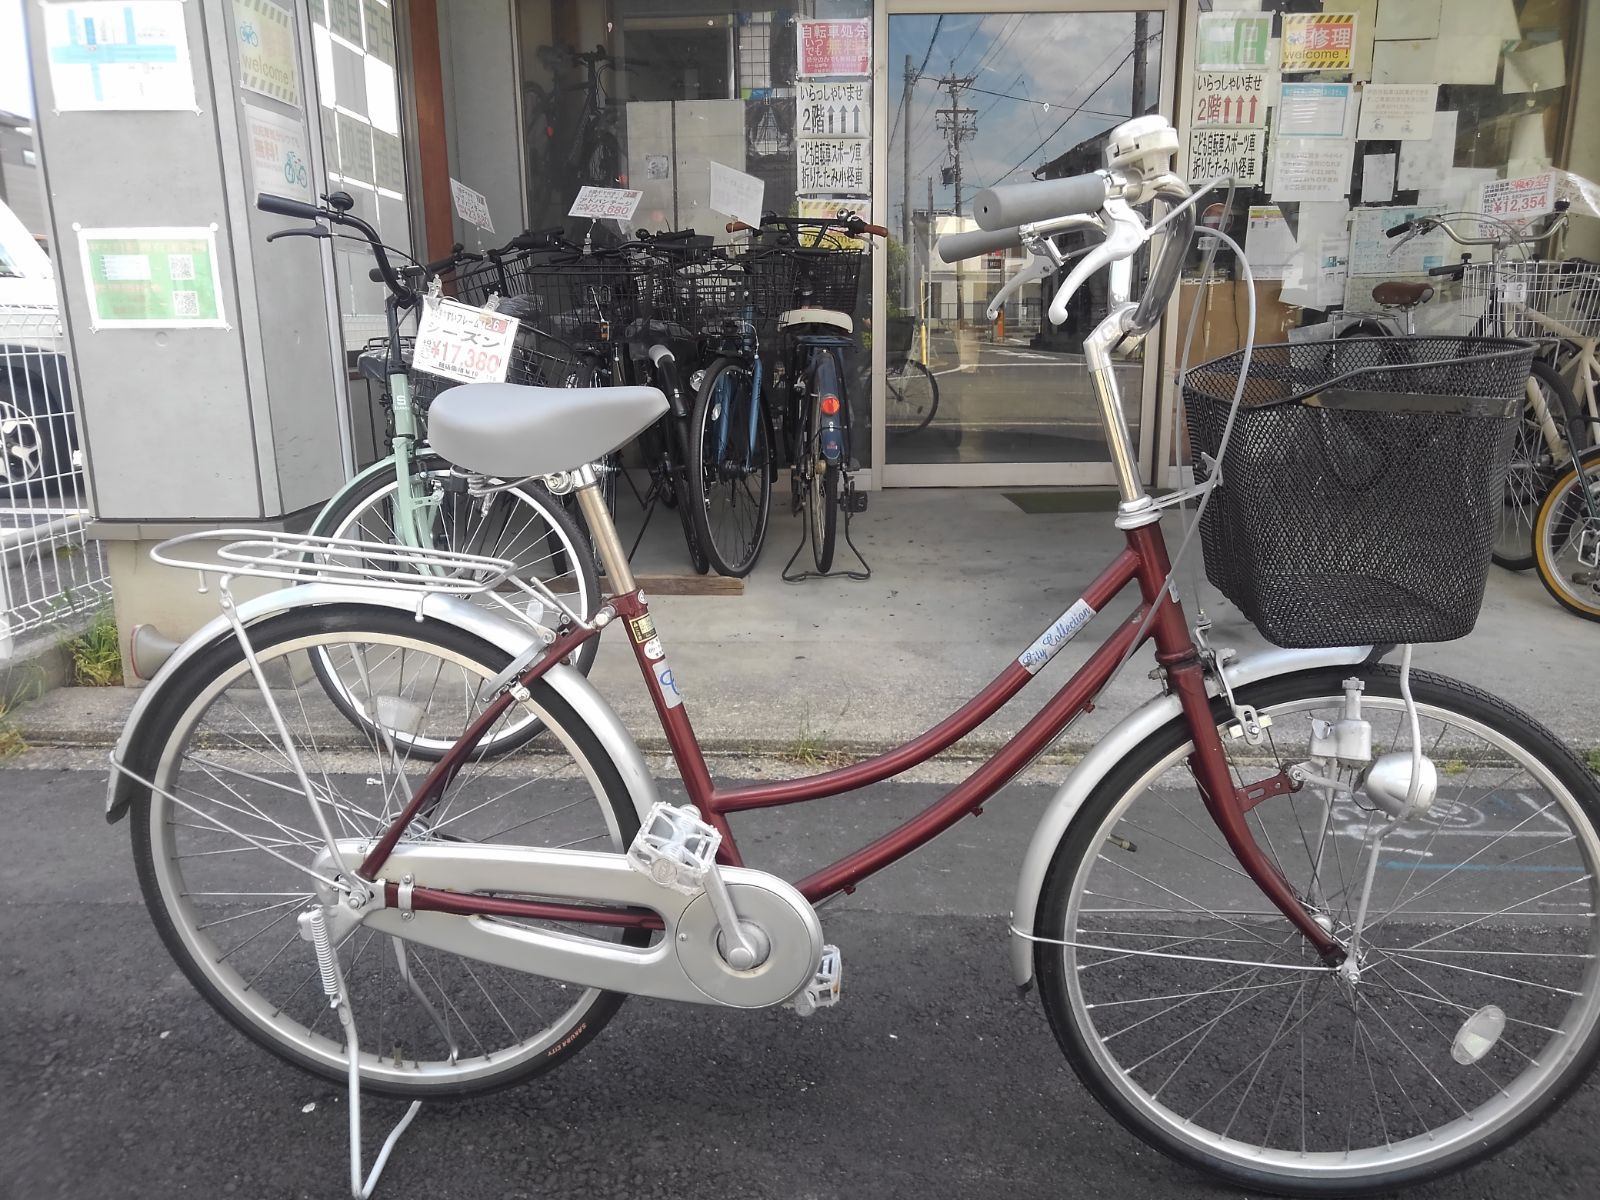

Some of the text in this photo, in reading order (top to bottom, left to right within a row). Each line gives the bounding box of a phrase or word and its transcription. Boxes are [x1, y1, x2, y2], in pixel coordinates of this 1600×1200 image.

[803, 25, 867, 39] 自転車処分
[1311, 27, 1350, 49] 修理
[1284, 49, 1339, 60] welcome
[242, 55, 289, 86] welcome
[1197, 74, 1262, 91] いらっしゃいませ
[800, 84, 863, 101] いらっしゃいませ
[802, 104, 825, 133] 2階
[1197, 94, 1221, 123] 2階
[800, 141, 862, 166] こども自転車スポーツ車
[1192, 131, 1256, 156] こども自転車スポーツ車
[802, 166, 863, 189] 折りたたみ小径車
[1192, 157, 1255, 179] 折りたたみ小径車
[1494, 195, 1546, 213] ¥12,354
[427, 321, 500, 348] シーズン
[431, 341, 500, 374] ¥17,380
[1022, 607, 1091, 667] City Collection
[547, 1023, 587, 1057] SAKURA CITY
